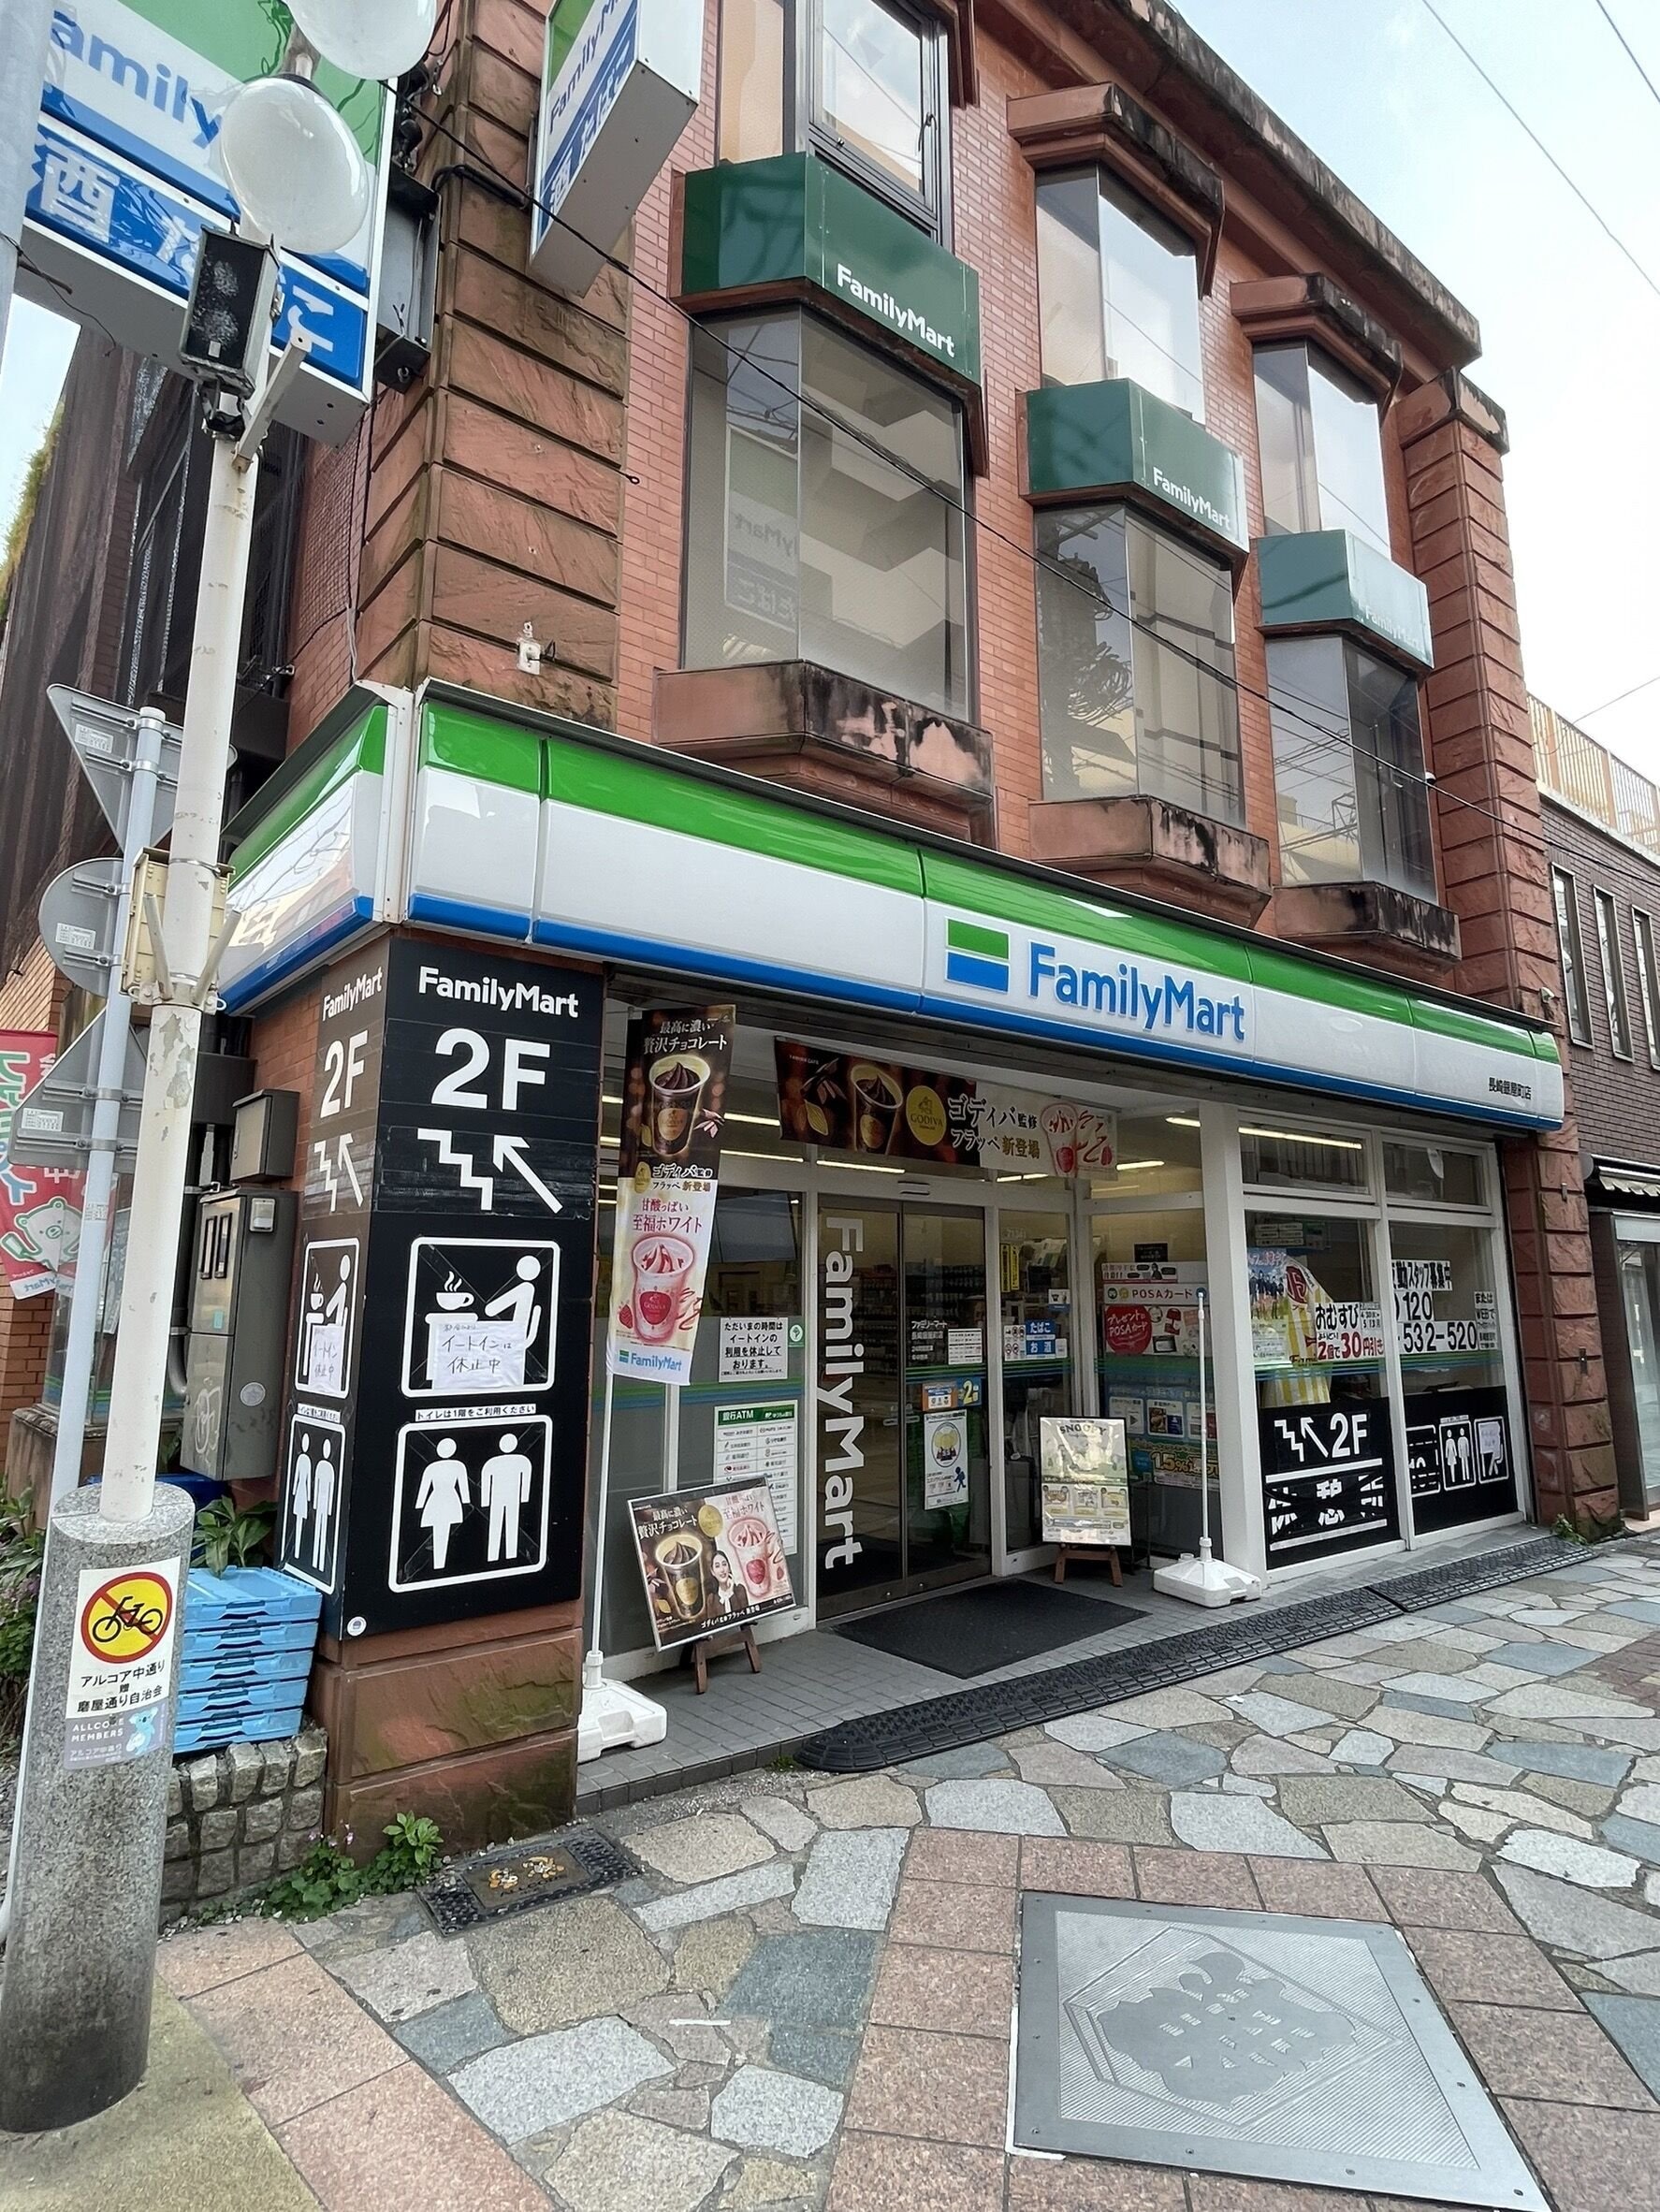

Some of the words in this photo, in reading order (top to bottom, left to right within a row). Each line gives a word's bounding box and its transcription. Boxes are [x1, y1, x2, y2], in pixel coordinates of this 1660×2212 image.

[548, 0, 619, 136] FamilyM
[837, 263, 955, 358] FamilyMart
[1153, 466, 1230, 531] FamilyMart
[322, 966, 383, 1022] FamilyMart
[418, 965, 579, 1018] FamilyMart
[1028, 939, 1245, 1041] FamilyMart
[660, 1019, 711, 1034] 最高に濃い
[644, 1034, 728, 1055] 贅沢チョコレート
[320, 1029, 368, 1119] 2F
[431, 1027, 551, 1111] 2F
[910, 1113, 943, 1128] GODIVA
[948, 1093, 1038, 1129] ゴディバ監修
[642, 1198, 689, 1213] 甘酸っぱい
[633, 1214, 703, 1234] 至福ホワイト
[1132, 1289, 1193, 1300] POSAカード
[725, 1321, 783, 1332] ただいまの時間は
[1316, 1303, 1359, 1330] おむすび
[1030, 1321, 1051, 1333] たばこ
[1110, 1321, 1148, 1336] POSAカード
[730, 1333, 778, 1344] イートインの
[725, 1346, 782, 1358] 利用を休止して
[446, 1356, 501, 1375] 休止中
[631, 1353, 683, 1372] FamilyMart
[733, 1359, 769, 1370] おります。
[817, 1217, 865, 1569] FamilyMart
[417, 1405, 534, 1420] トイレは1階をご利用ください
[1330, 1412, 1367, 1459] 2F
[638, 1518, 698, 1539] 贅沢チョコレート
[80, 1659, 166, 1688] アルコア中通り
[77, 1684, 163, 1713] 磨屋通り自治会
[71, 1728, 124, 1742] MEMBERS
[72, 1717, 124, 1733] ALLCOE
